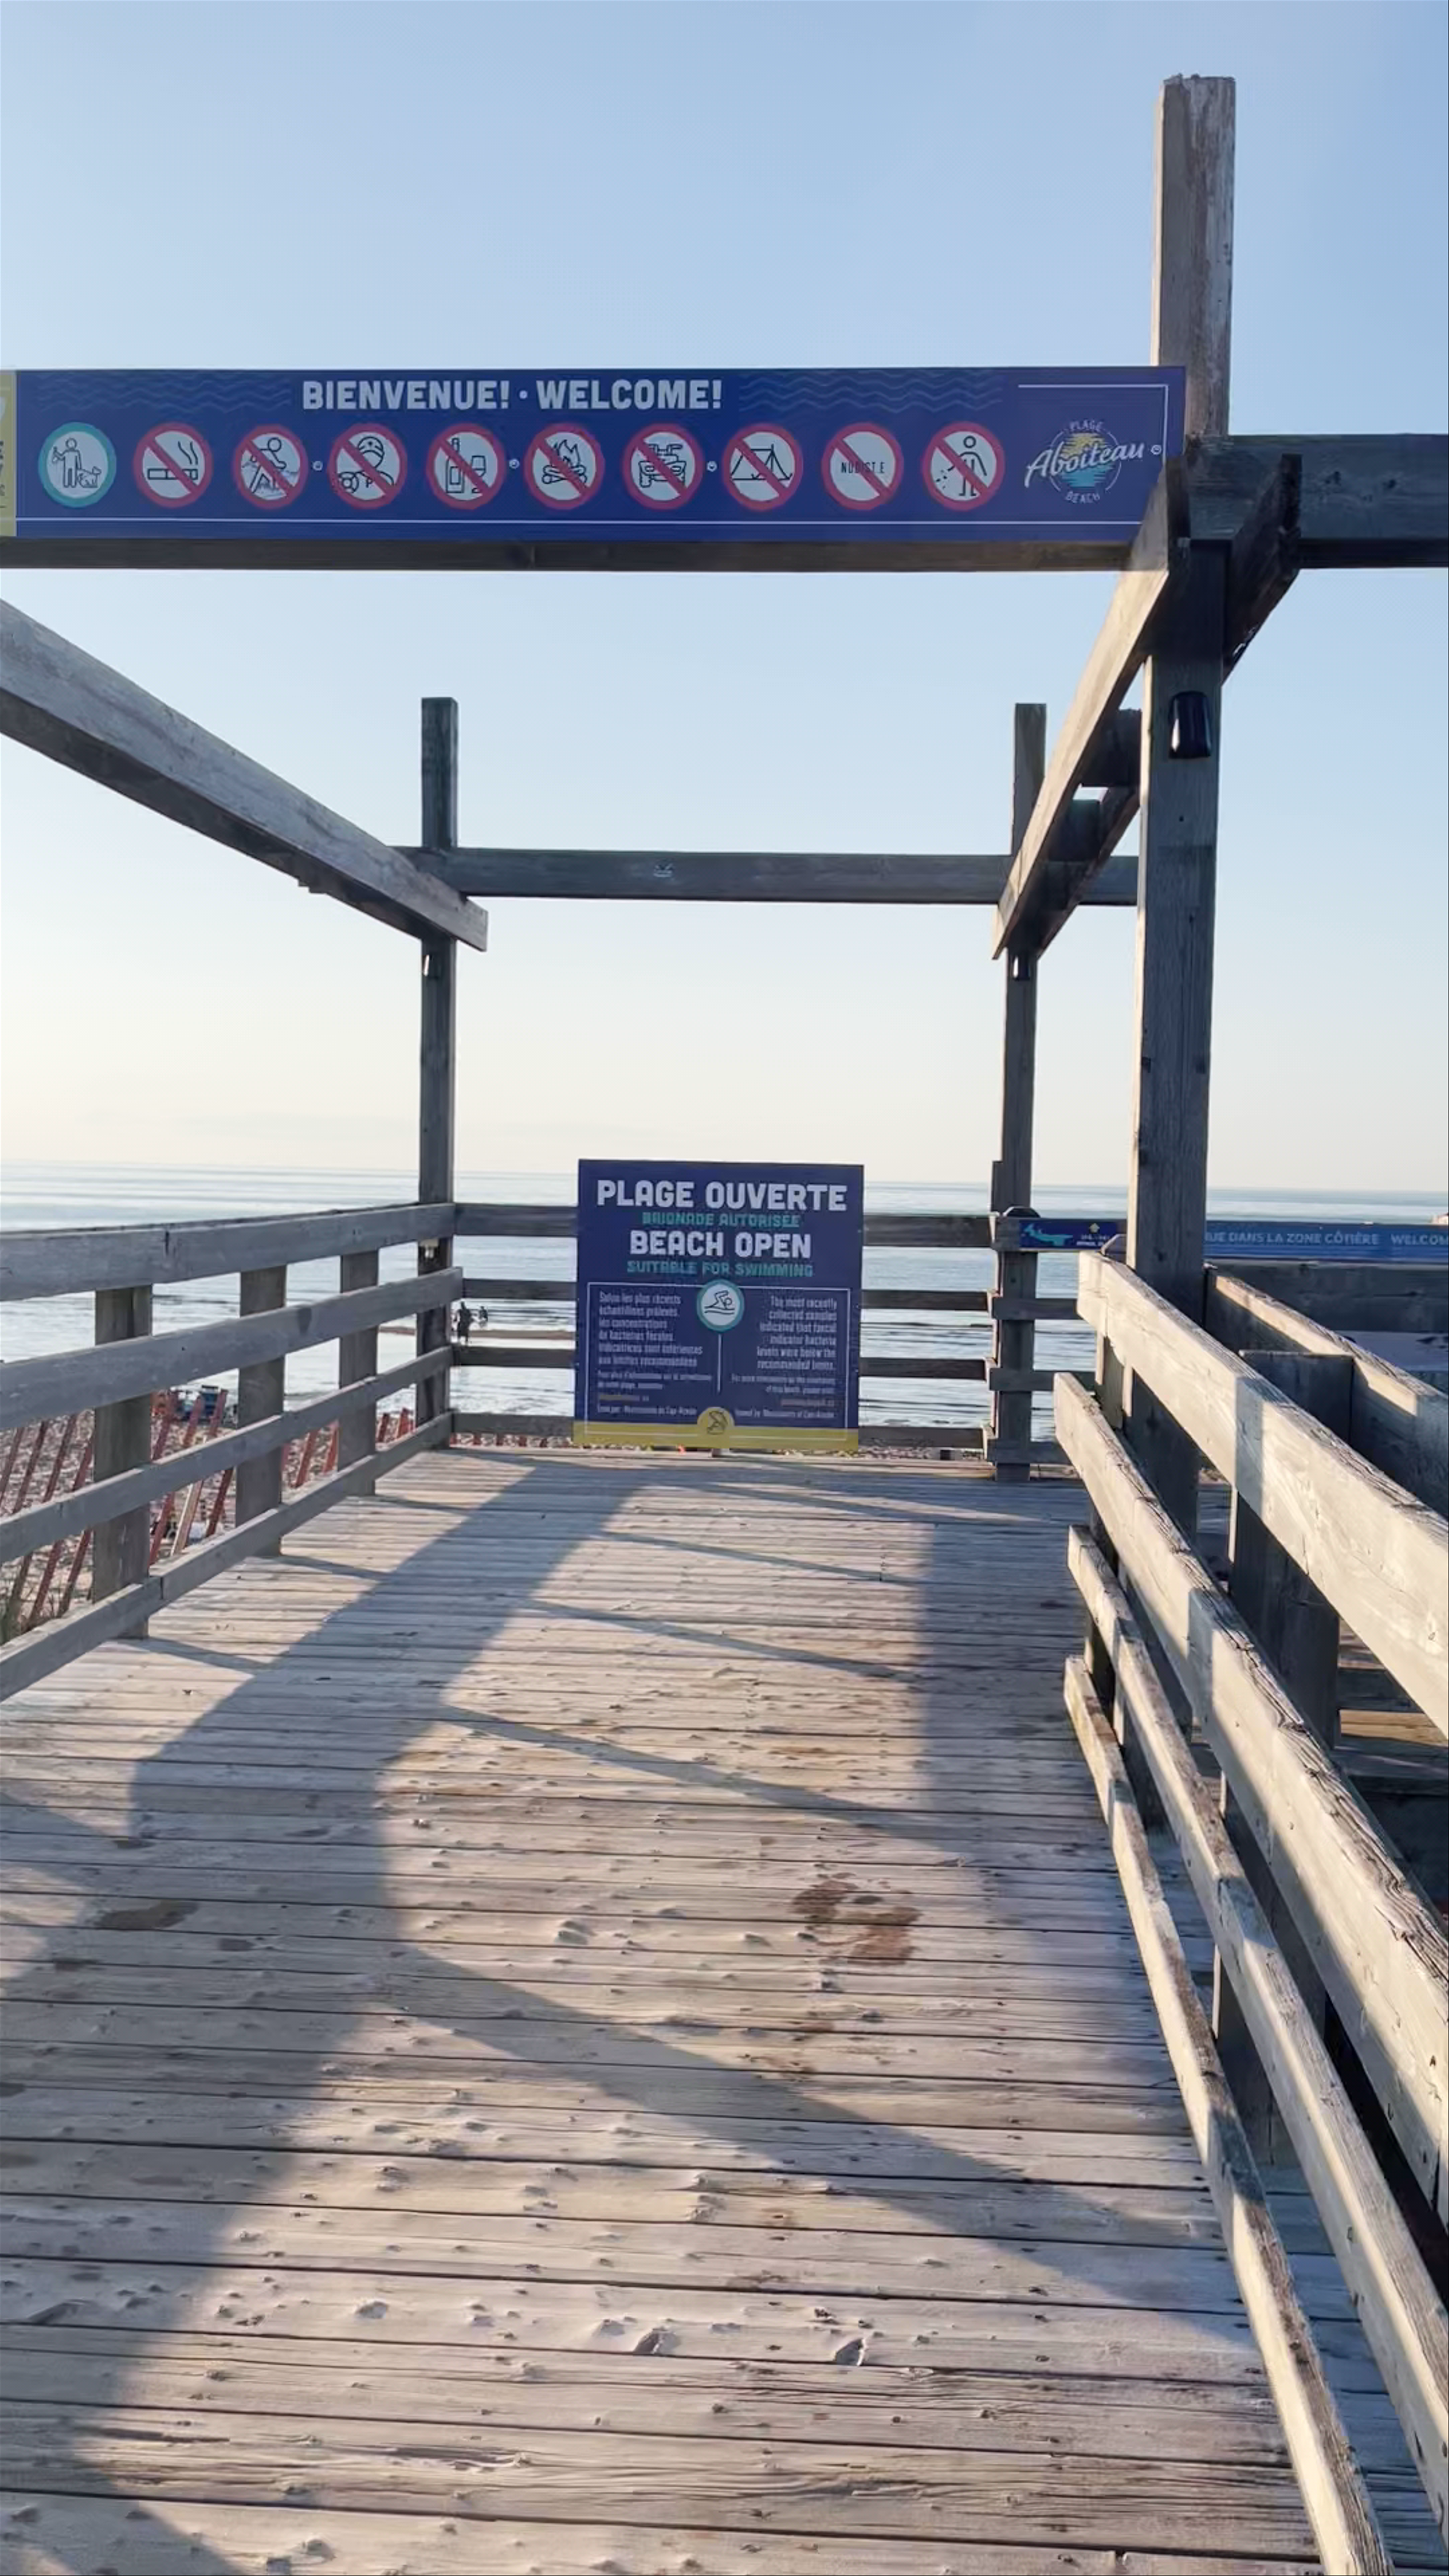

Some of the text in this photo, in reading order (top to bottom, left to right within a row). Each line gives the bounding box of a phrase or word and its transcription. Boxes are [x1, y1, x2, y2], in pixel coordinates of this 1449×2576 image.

[303, 380, 722, 410] BIENVENUE! WELCOME!
[1069, 420, 1104, 432] PLAGE
[1024, 441, 1145, 488] Aboiteau
[1065, 491, 1101, 503] BEACH
[597, 1180, 847, 1211] PLAGE OUVERTE
[630, 1230, 811, 1259] BEACH OPEN
[1266, 1233, 1283, 1243] LA
[1287, 1233, 1321, 1244] ZONE
[627, 1261, 813, 1278] SUITABLE FOR SWIMMING
